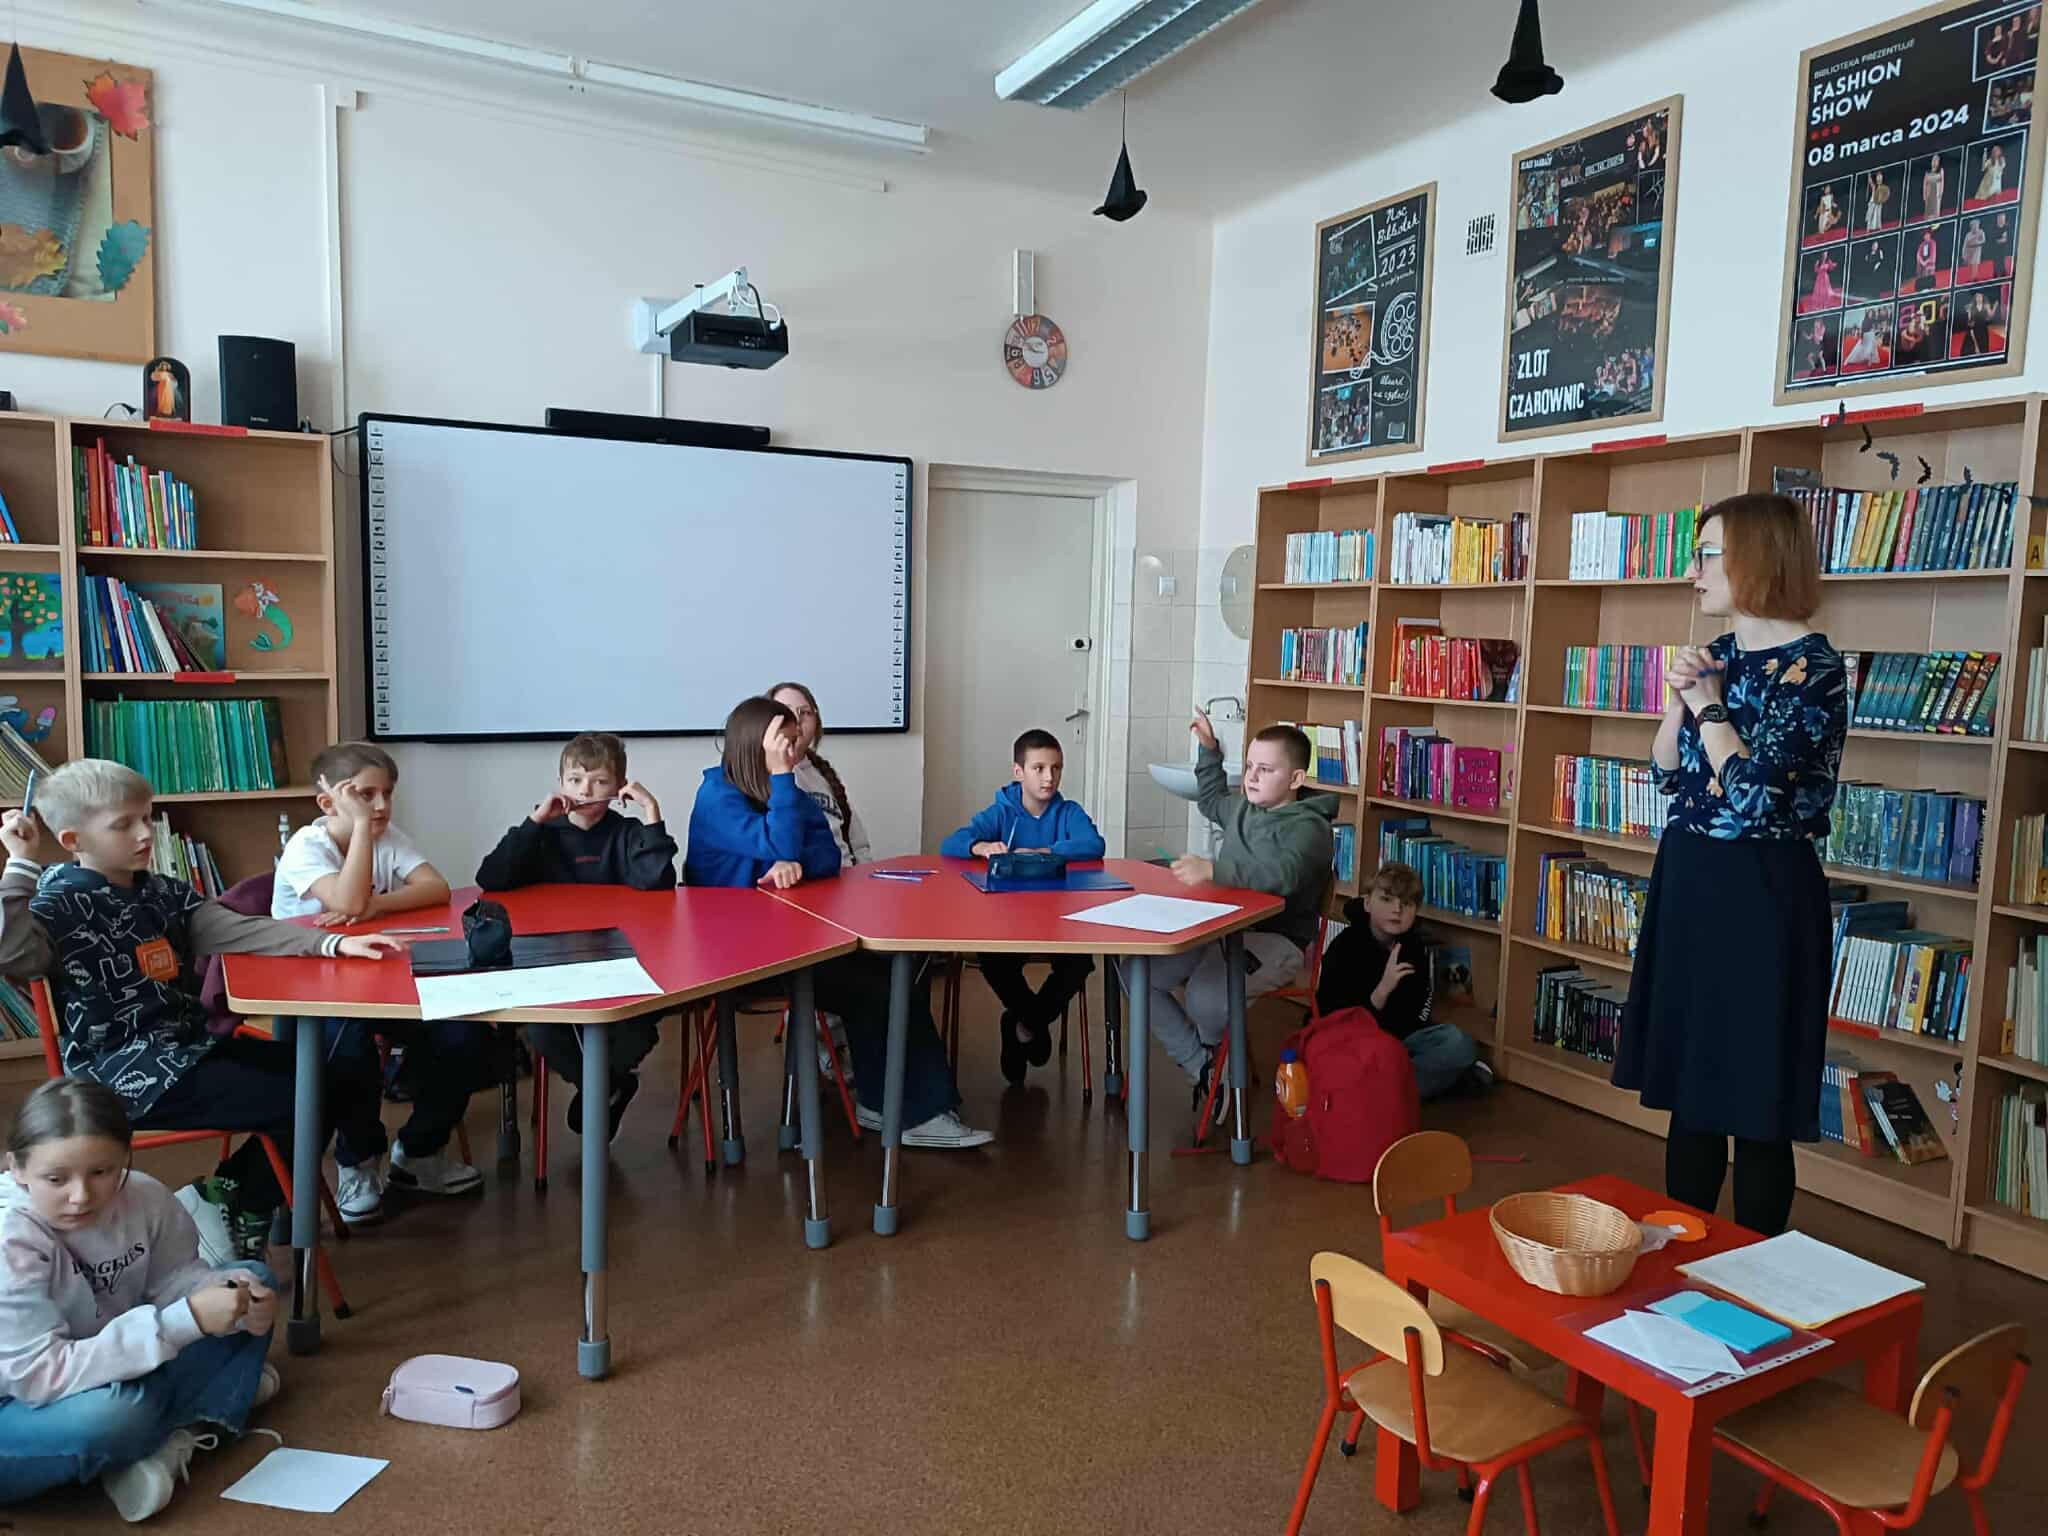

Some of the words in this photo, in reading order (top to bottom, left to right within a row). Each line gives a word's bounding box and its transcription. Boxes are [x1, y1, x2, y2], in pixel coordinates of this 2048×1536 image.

[1813, 57, 1860, 80] BIBLIOTEKA
[1861, 38, 1915, 63] PREZENTUJE
[1812, 58, 1902, 103] FASHION
[1810, 90, 1873, 126] SHOW
[1807, 143, 1835, 167] 08
[1839, 127, 1904, 159] marca
[1908, 104, 1970, 140] 2024
[1378, 243, 1416, 278] 2023
[1516, 348, 1551, 380] ZLOT
[1508, 382, 1586, 420] CZAROWNIC
[2031, 543, 2041, 563] A
